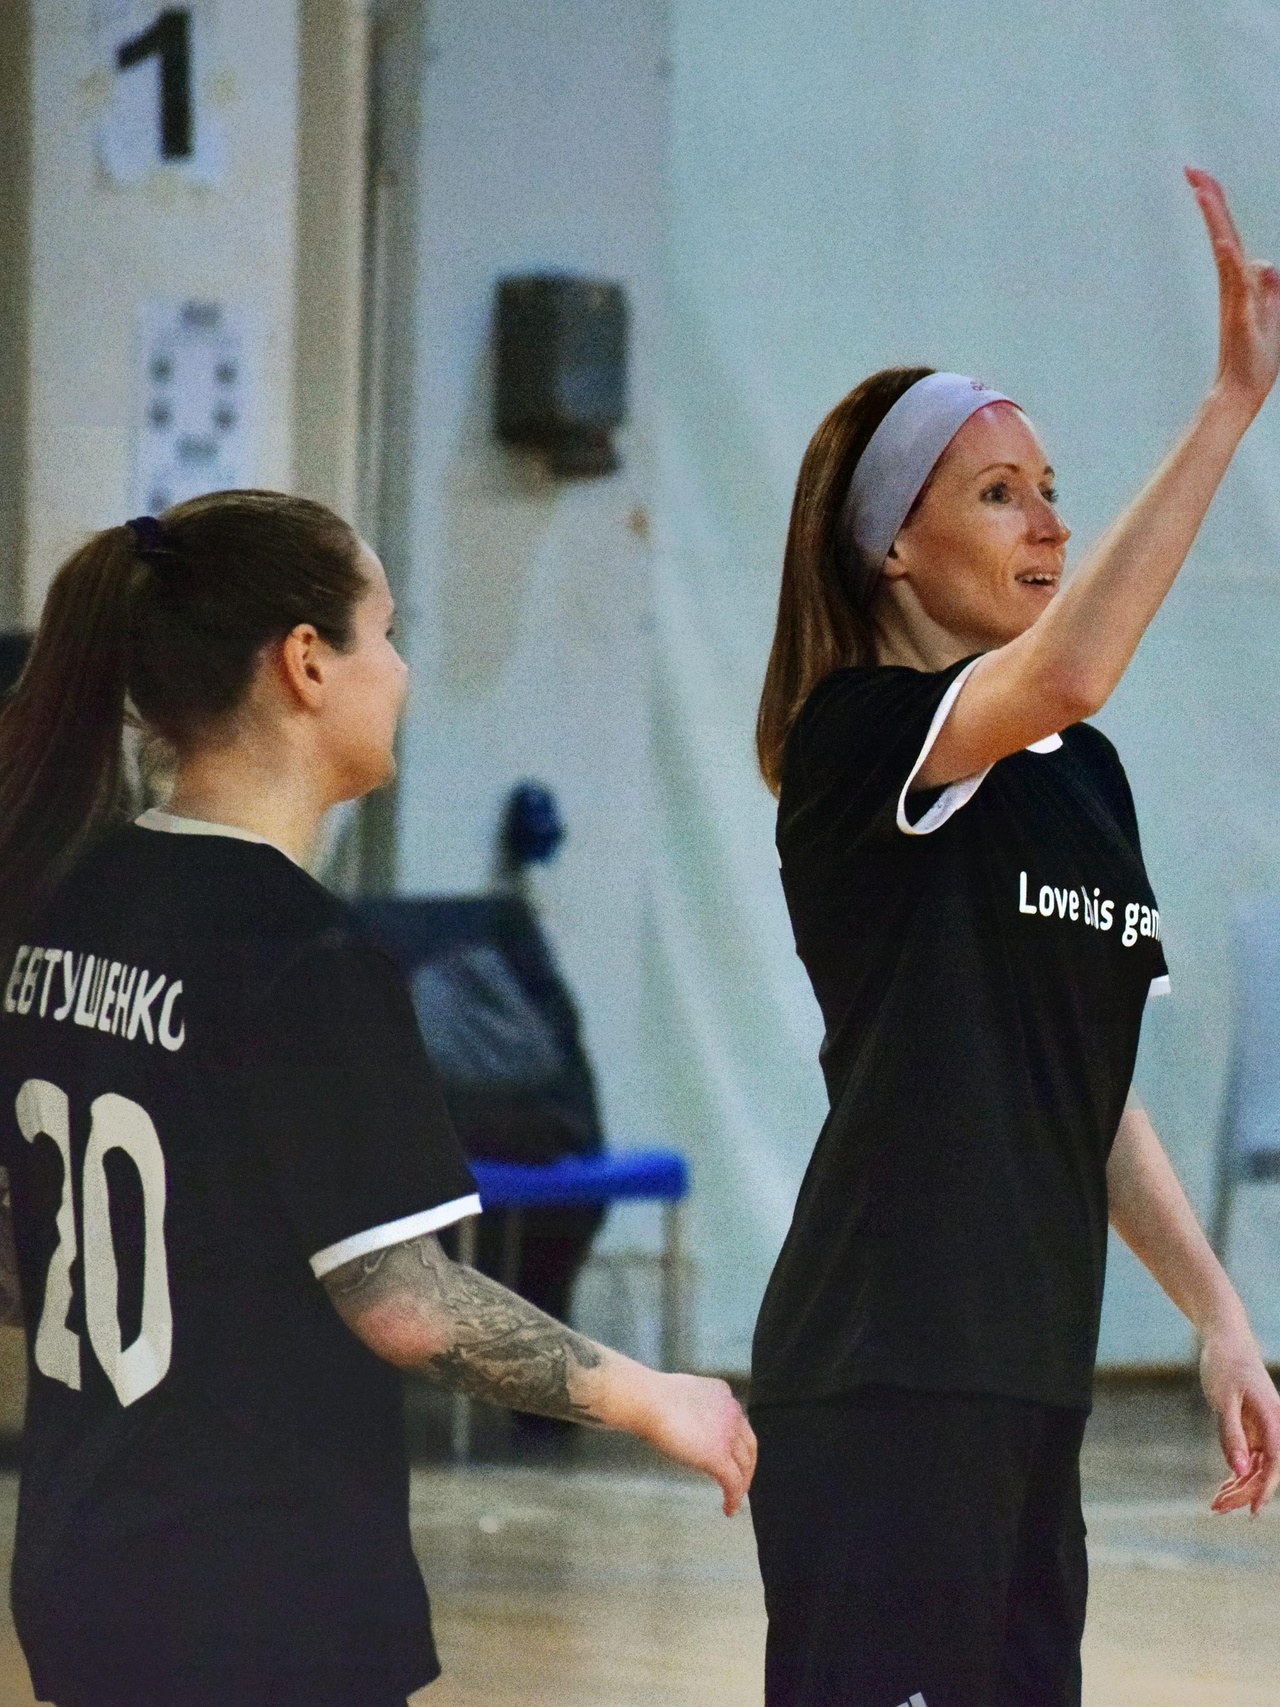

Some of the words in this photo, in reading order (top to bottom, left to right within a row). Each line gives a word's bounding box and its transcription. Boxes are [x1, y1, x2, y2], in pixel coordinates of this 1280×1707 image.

[115, 9, 195, 161] 1
[1019, 871, 1080, 921] Love
[15, 1078, 173, 1408] 20
